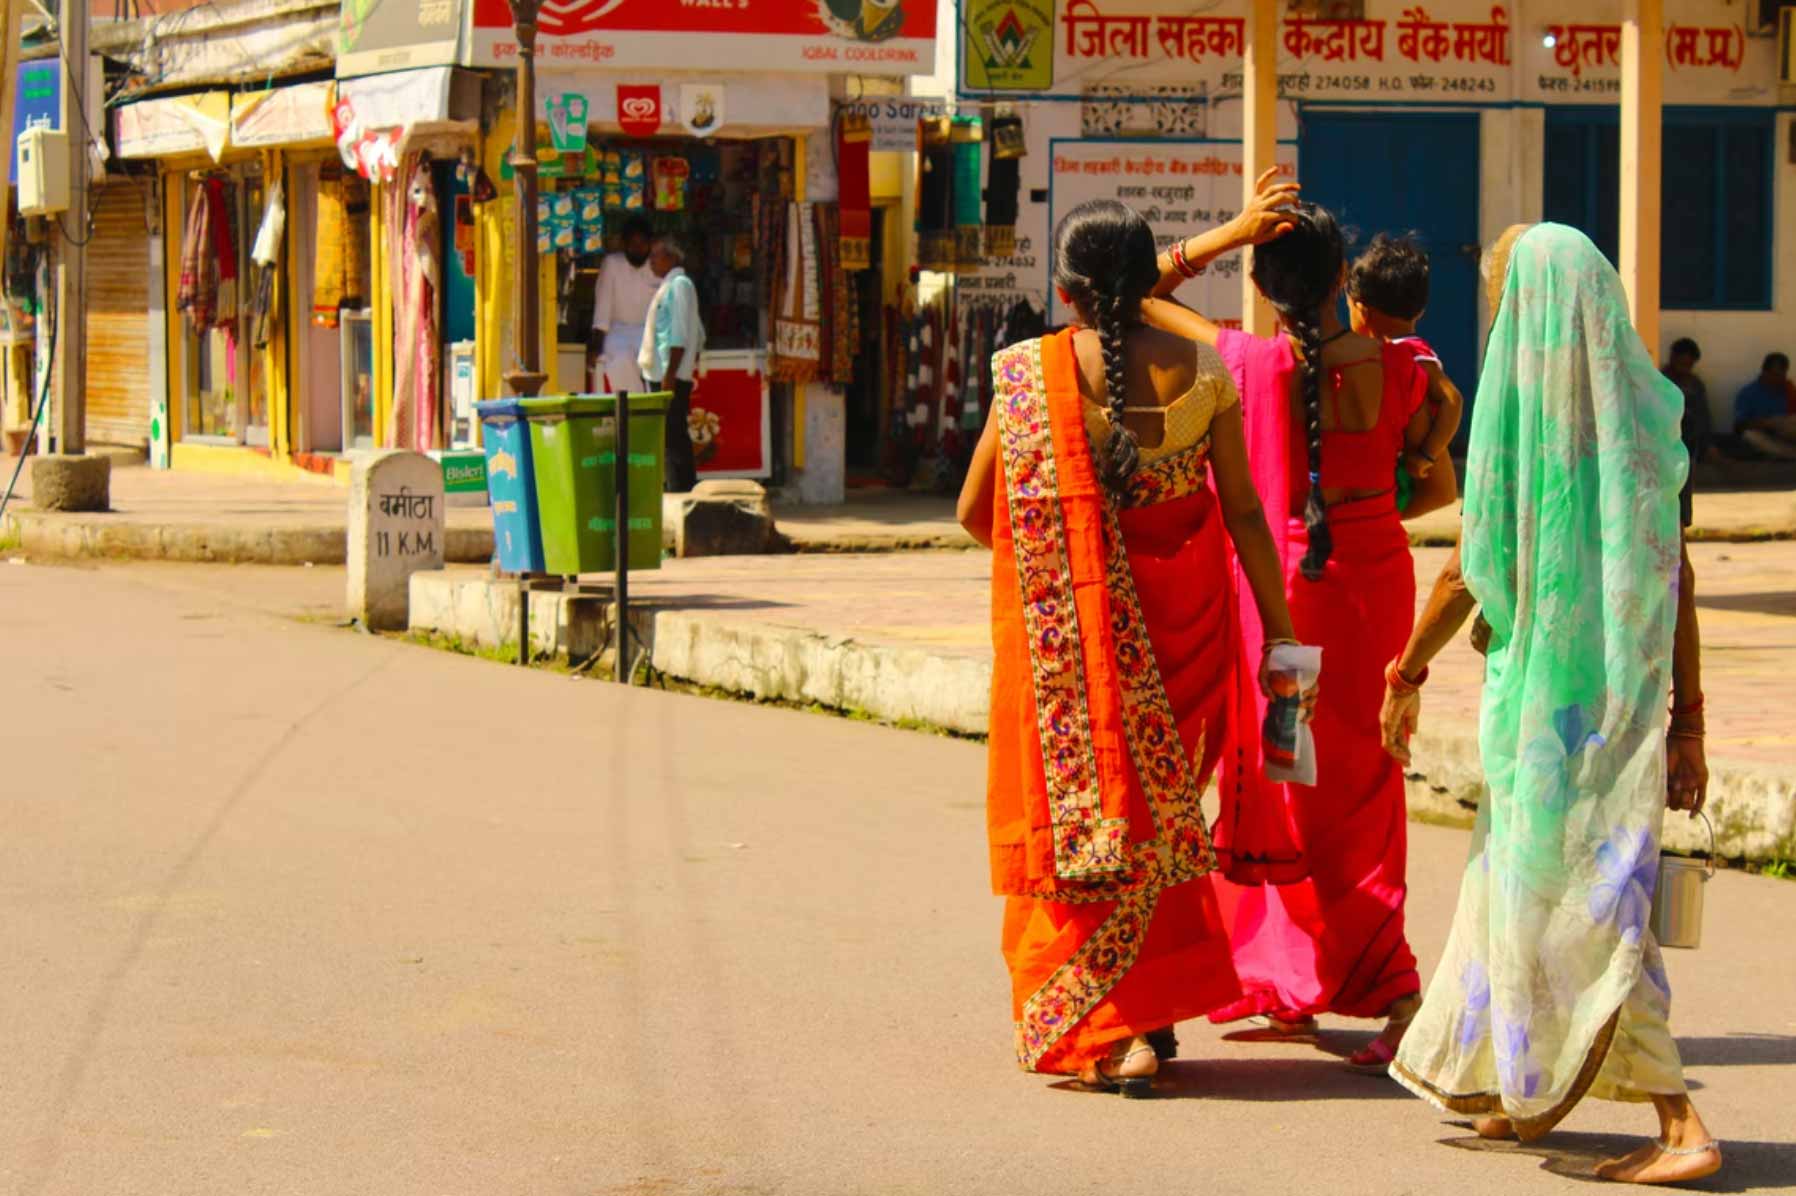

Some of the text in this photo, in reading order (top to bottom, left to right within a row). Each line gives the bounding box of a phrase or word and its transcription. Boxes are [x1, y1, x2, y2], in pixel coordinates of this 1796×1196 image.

[1062, 0, 1151, 58] जिला
[1157, 17, 1246, 64] सहका
[802, 45, 918, 62] IQBAL COOLDRINK
[1316, 75, 1371, 90] 274058
[376, 531, 438, 558] 11 K.M.
